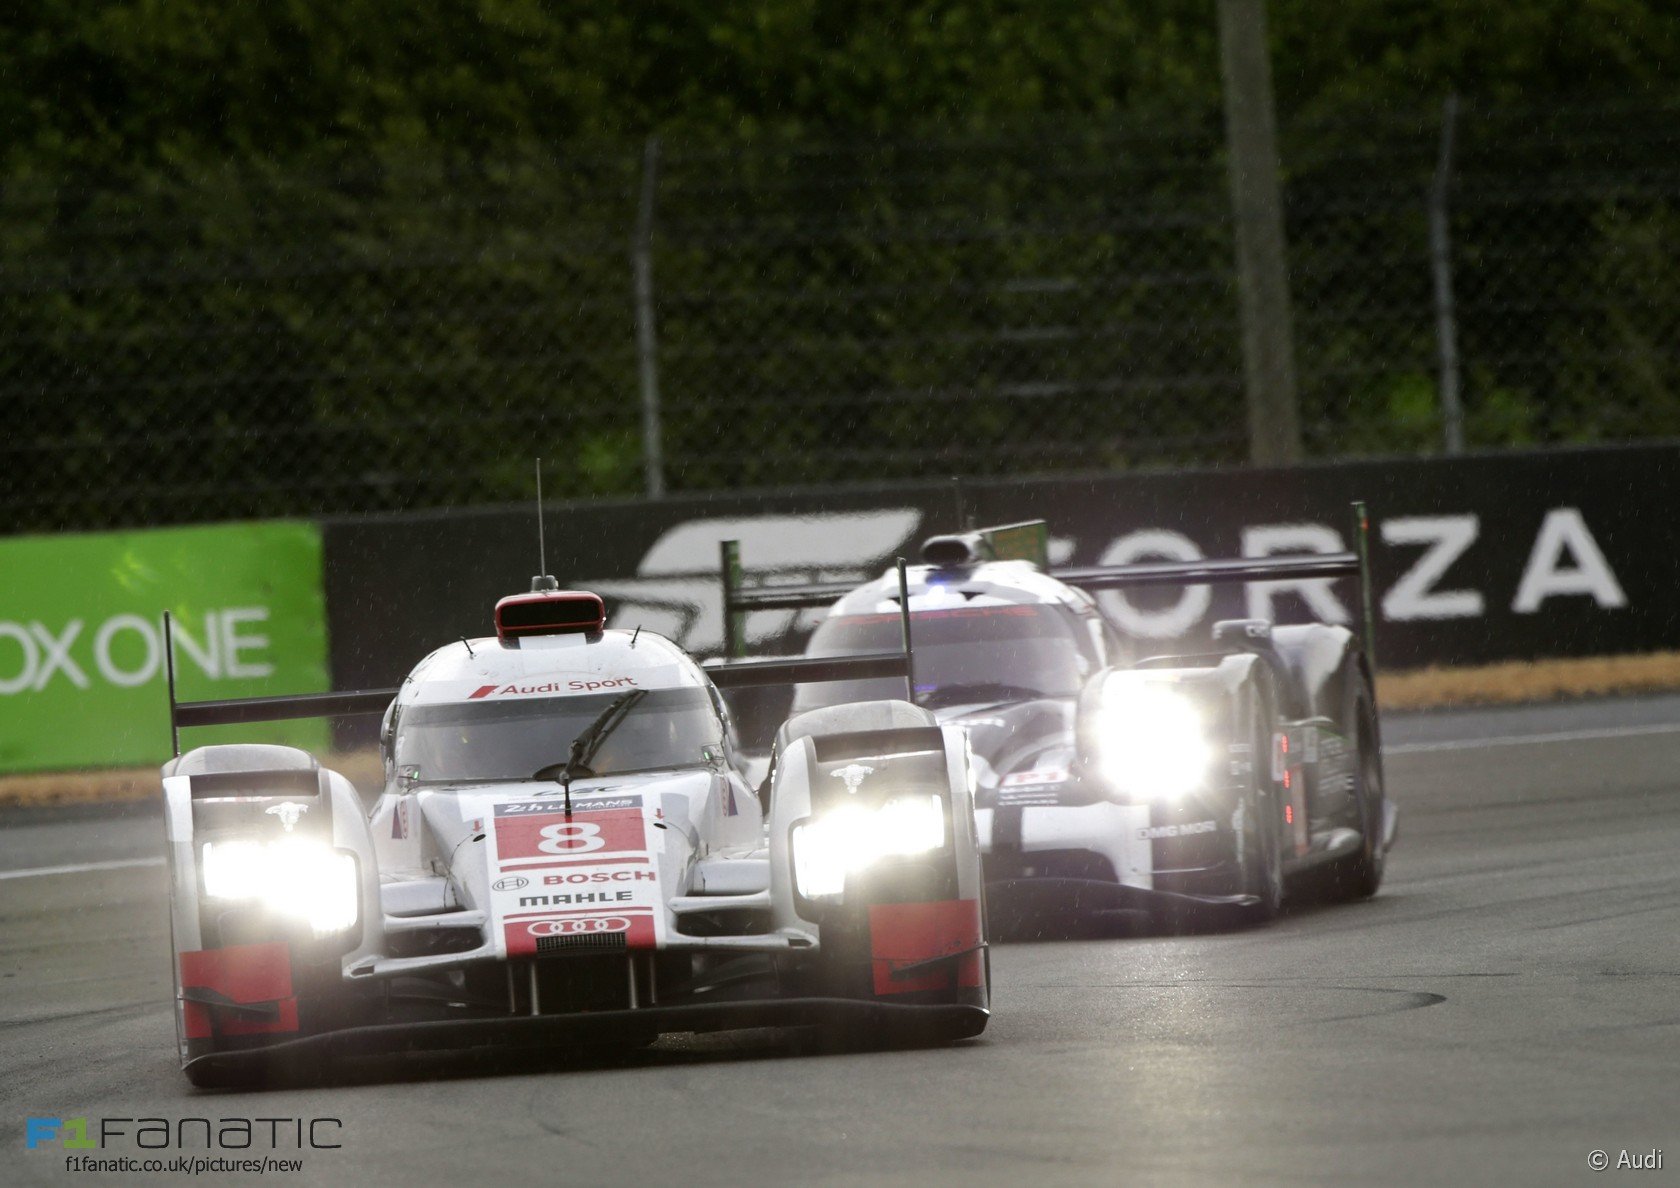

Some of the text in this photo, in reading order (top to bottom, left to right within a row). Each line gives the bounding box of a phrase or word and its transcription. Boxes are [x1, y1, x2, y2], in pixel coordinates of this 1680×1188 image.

[1046, 506, 1628, 640] ORZA
[93, 604, 274, 687] ONE
[499, 676, 638, 695] Audi Sport
[575, 799, 634, 809] MANS
[538, 822, 606, 854] 8
[543, 870, 656, 886] BOSCH
[519, 890, 633, 907] MAHLE
